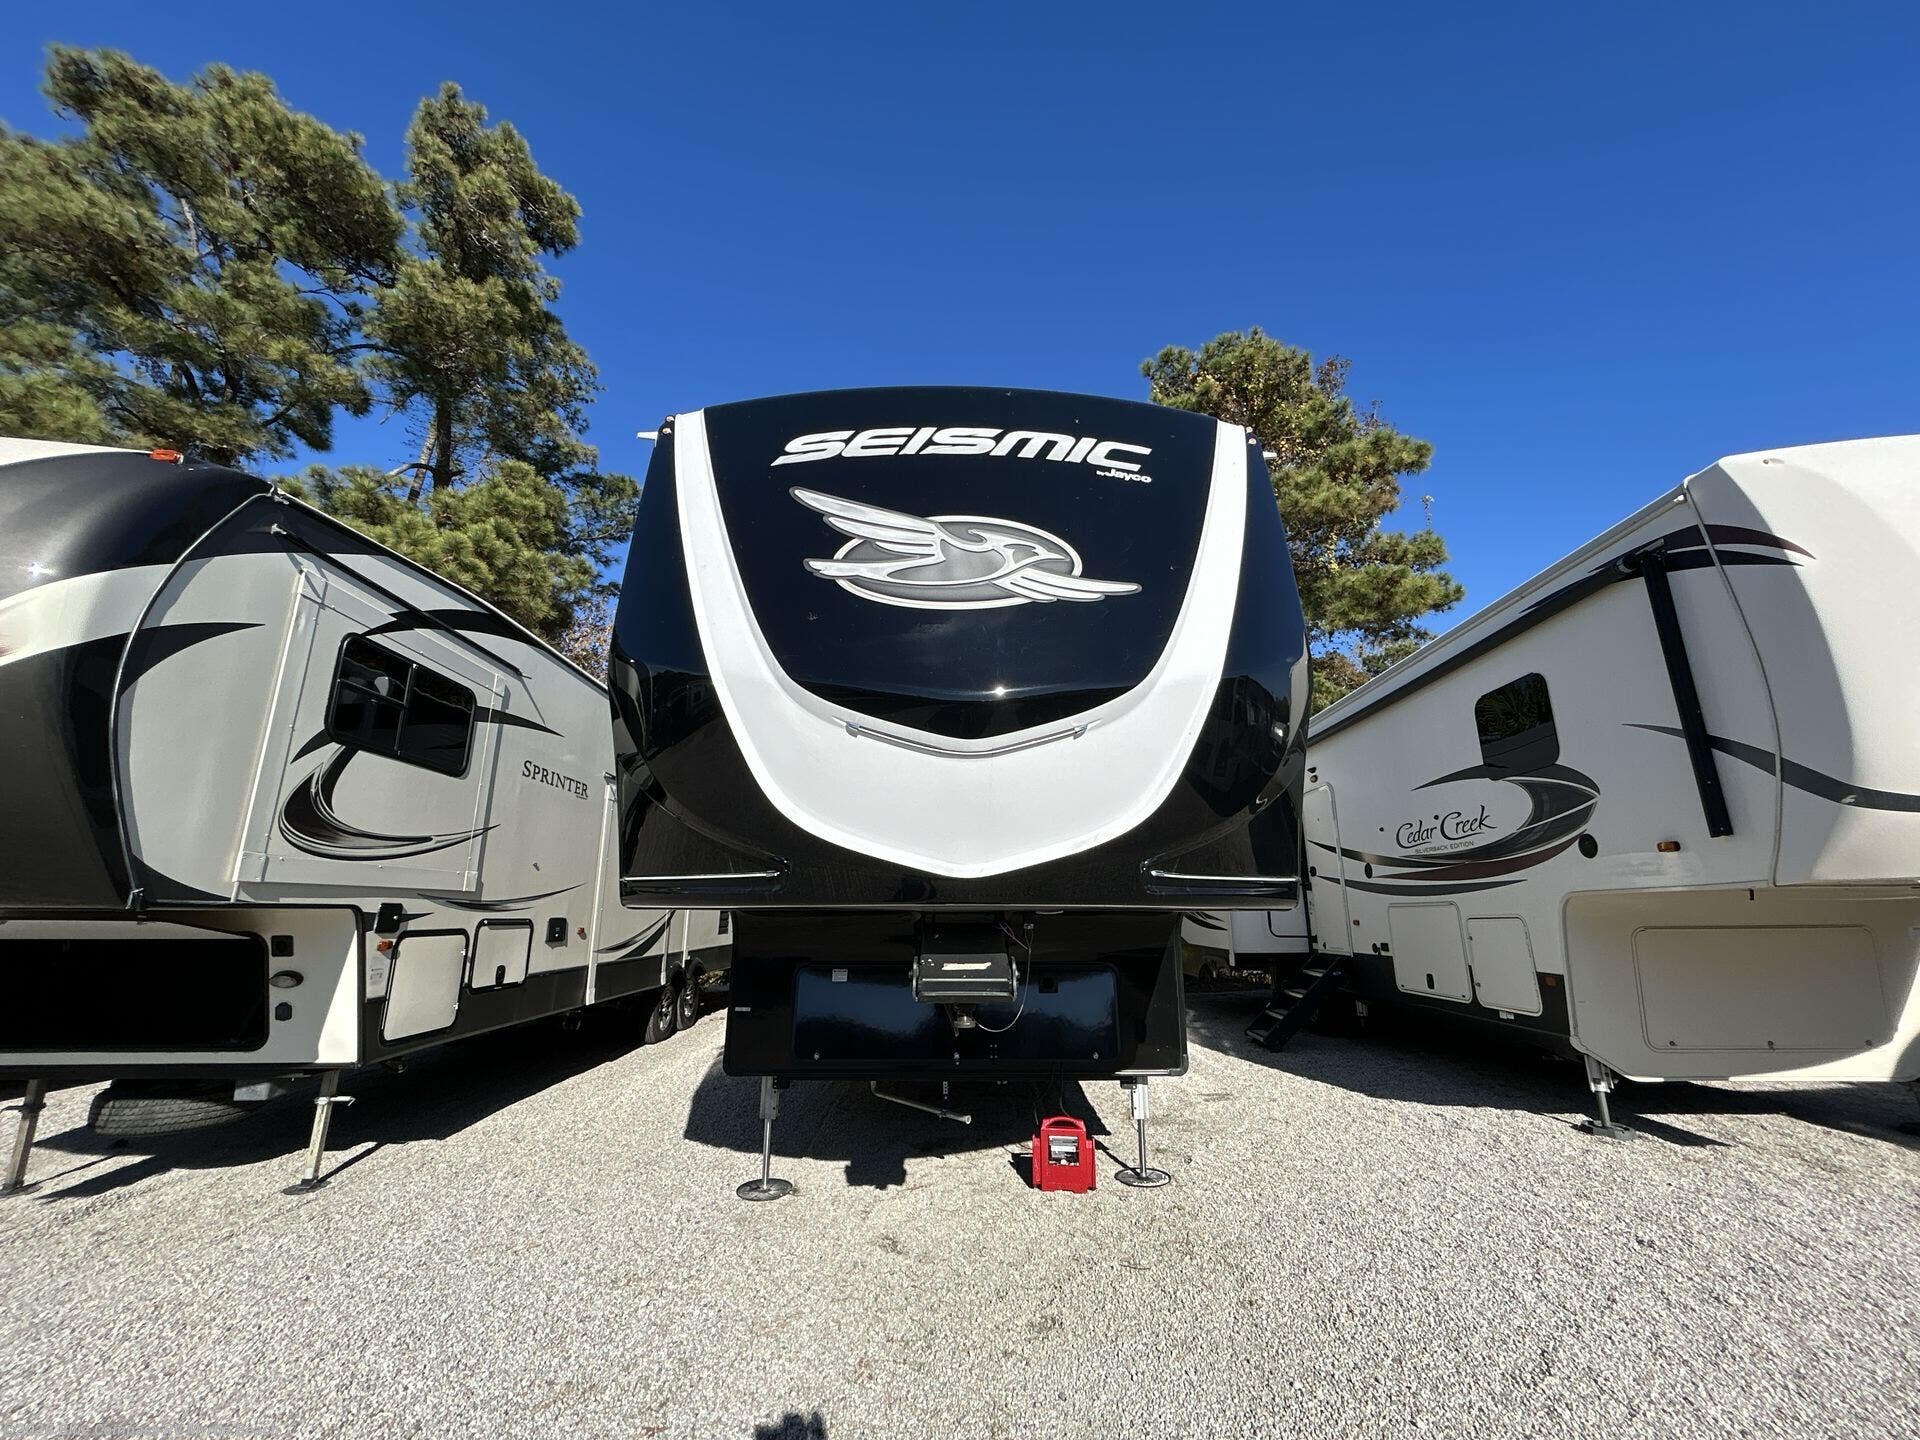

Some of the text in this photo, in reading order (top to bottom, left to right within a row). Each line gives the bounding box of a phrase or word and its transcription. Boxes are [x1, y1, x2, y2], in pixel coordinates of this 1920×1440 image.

[770, 426, 1152, 472] SEISMIC
[1105, 468, 1152, 483] Jayco
[522, 760, 589, 798] SPRINTER
[1396, 804, 1498, 849] Cedar Creek
[1415, 840, 1474, 854] SILVERBACK EDITION
